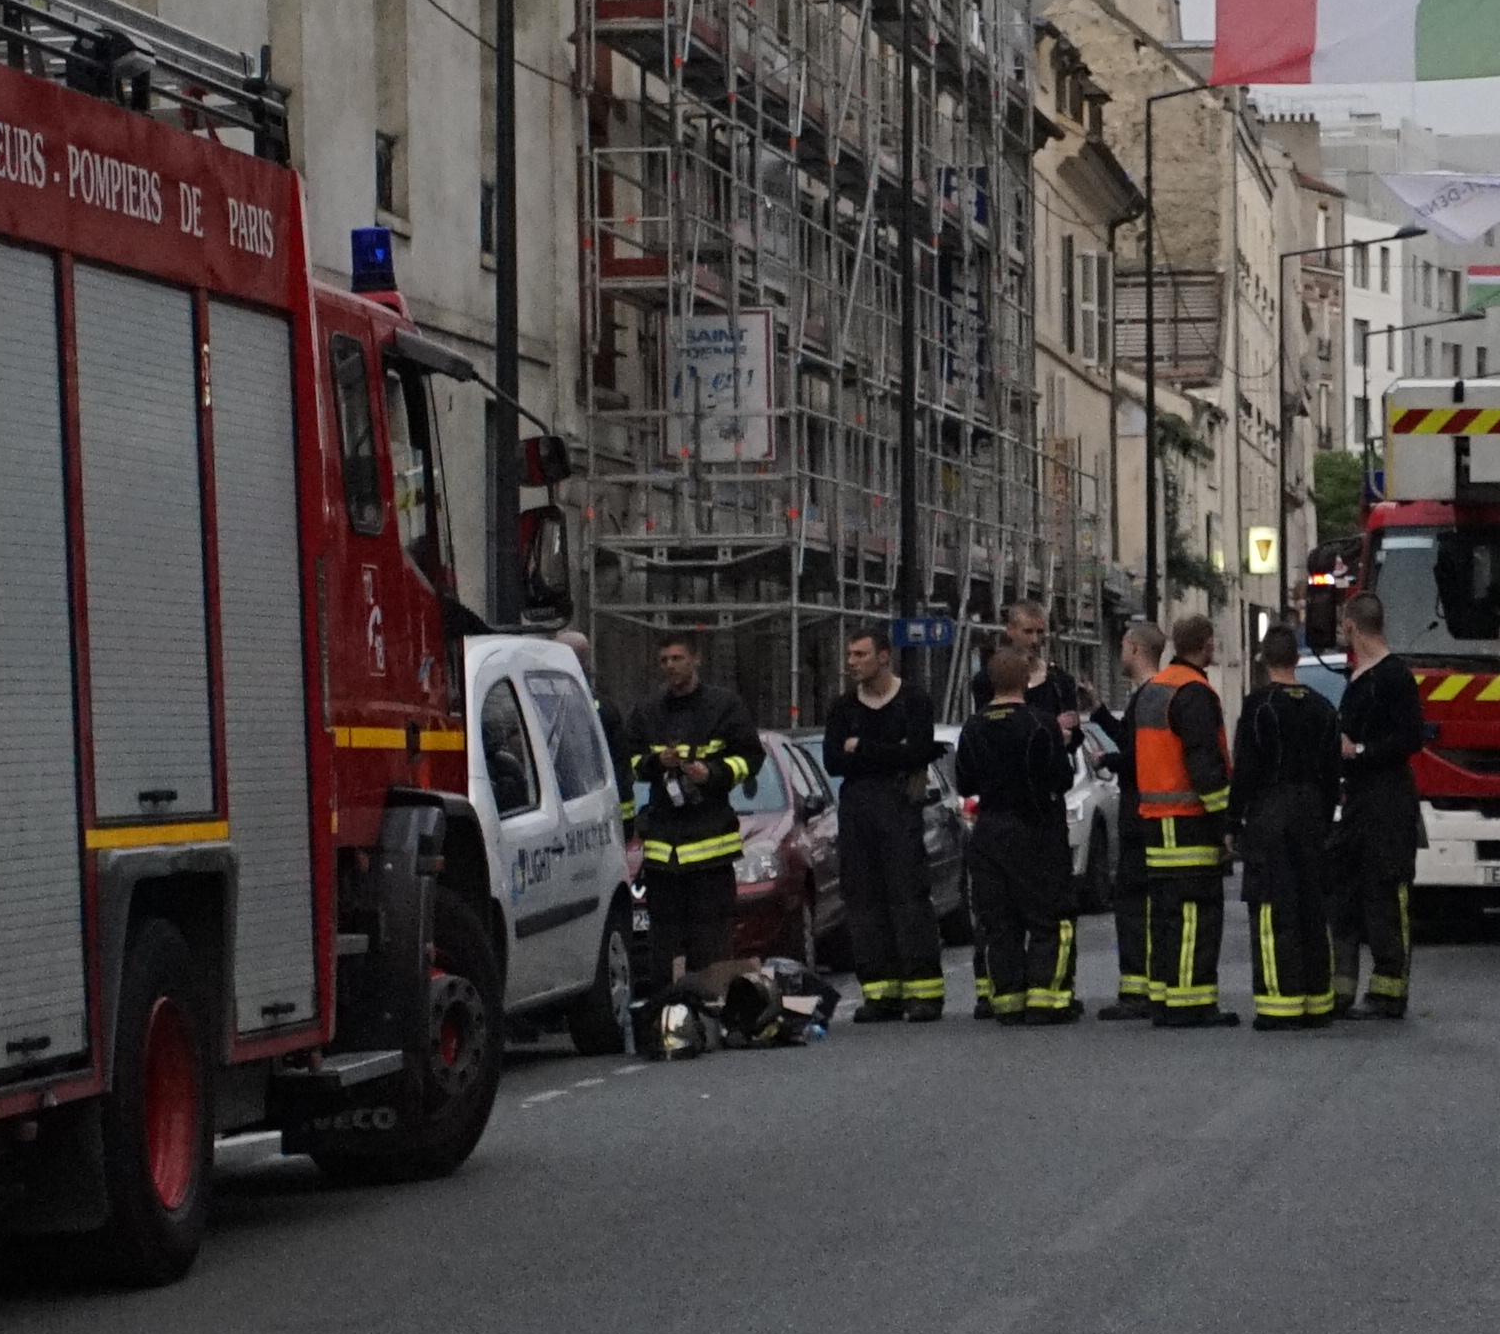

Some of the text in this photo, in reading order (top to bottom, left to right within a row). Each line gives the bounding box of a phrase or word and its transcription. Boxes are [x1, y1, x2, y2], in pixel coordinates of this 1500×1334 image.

[67, 144, 163, 224] POMPIERS
[179, 182, 204, 237] DE
[227, 197, 274, 259] PARIS
